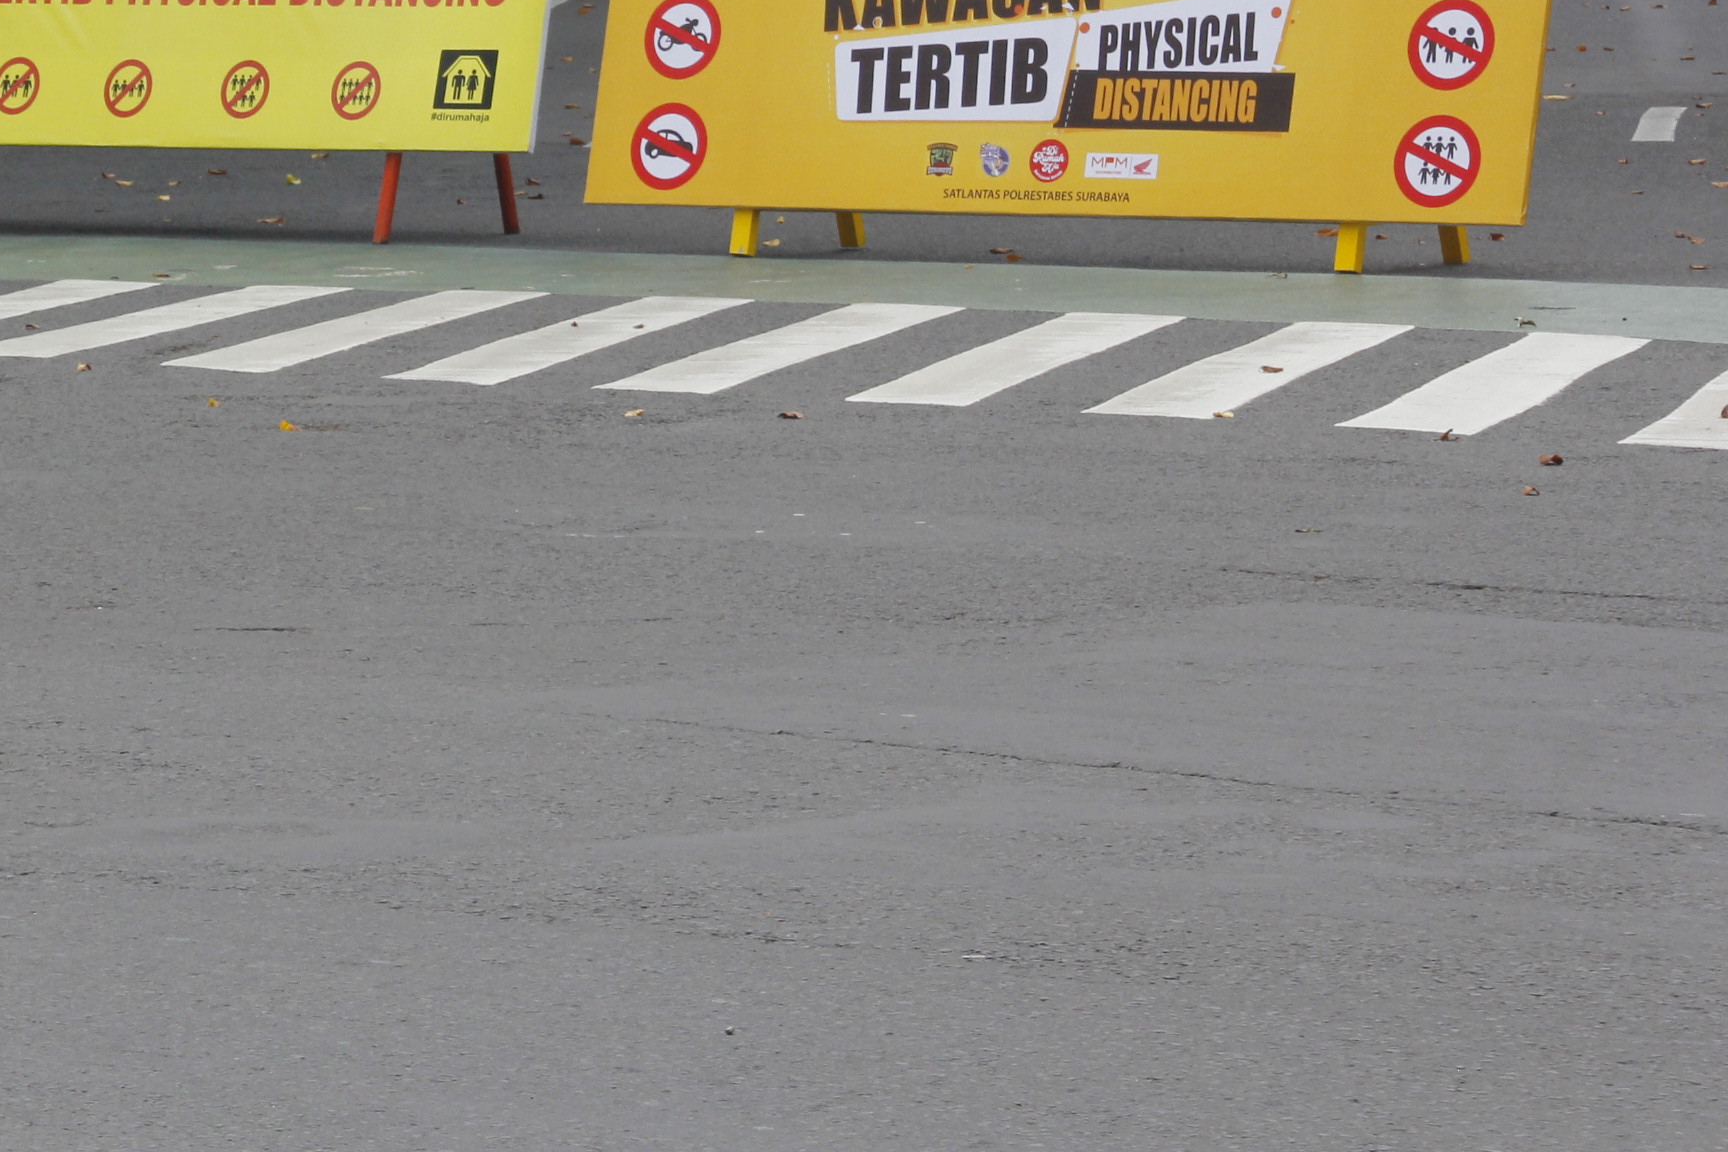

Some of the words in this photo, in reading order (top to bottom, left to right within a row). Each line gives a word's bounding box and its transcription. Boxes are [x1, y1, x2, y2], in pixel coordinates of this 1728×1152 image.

[1097, 11, 1259, 72] PHYSICAL
[850, 35, 1049, 115] TERTIB
[1092, 77, 1257, 124] DISTANCING
[431, 112, 490, 124] #dirumahaja
[1032, 152, 1065, 165] Rumah
[1090, 156, 1128, 169] MPM
[943, 189, 1001, 200] SATLANTAS
[1003, 190, 1073, 202] POLRESTABES
[1075, 191, 1130, 203] SURABAYA
